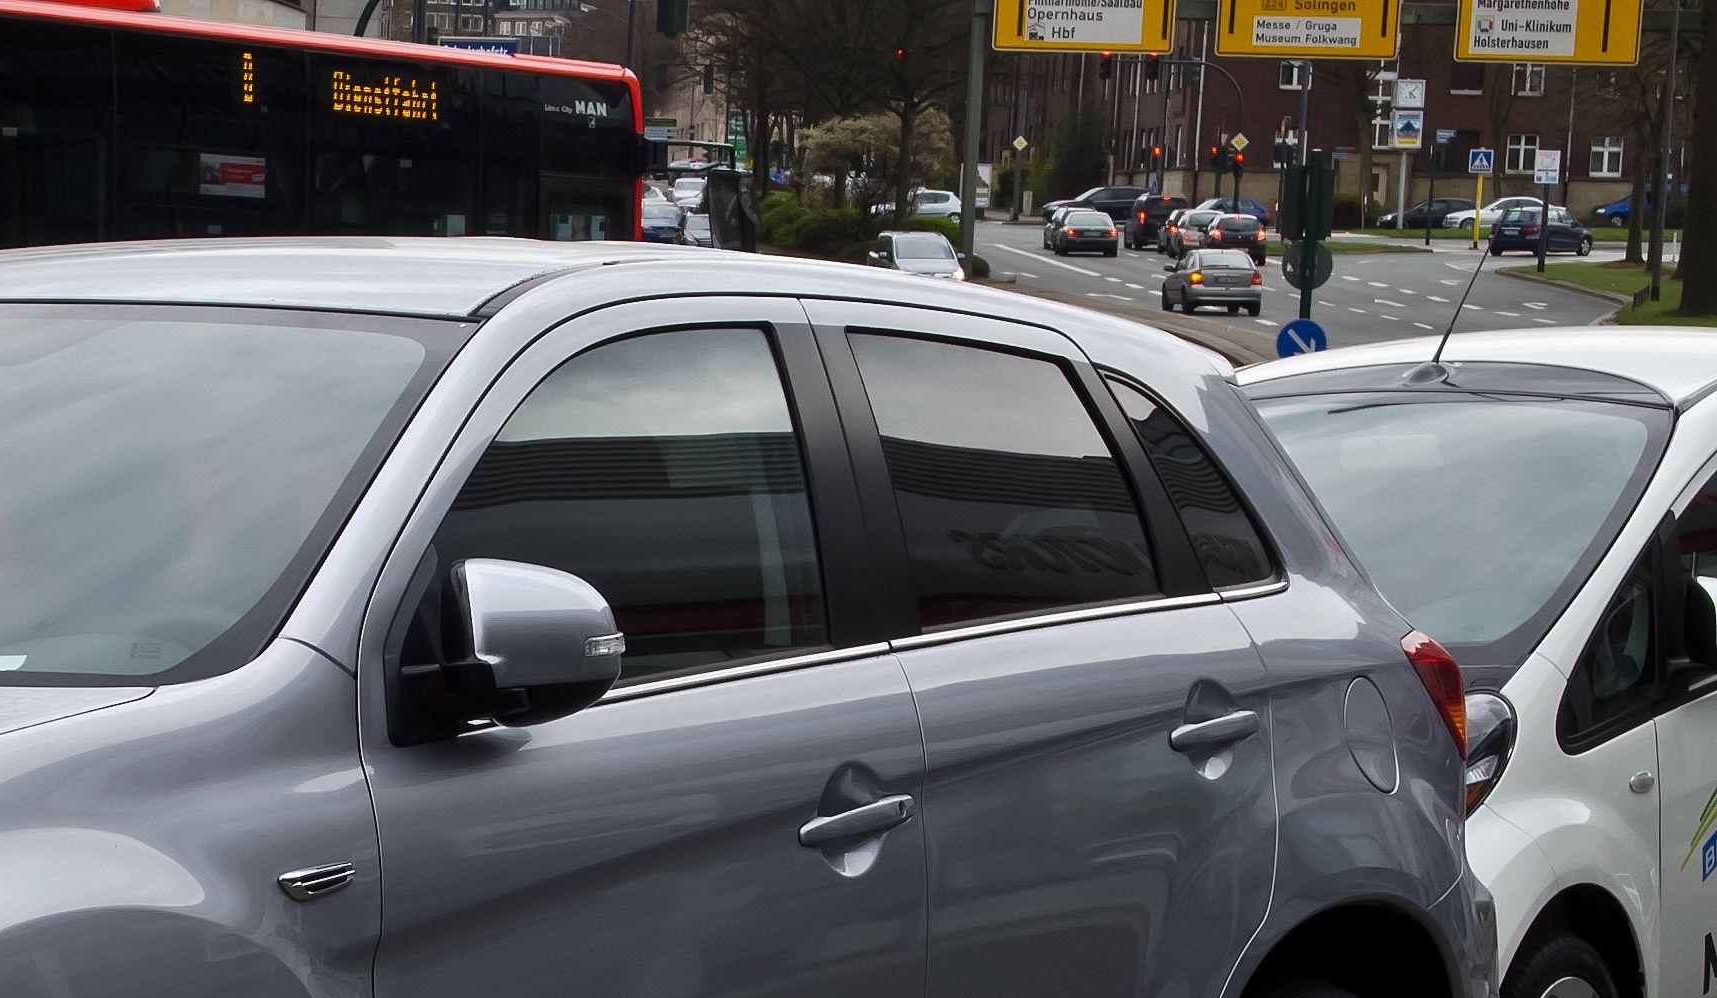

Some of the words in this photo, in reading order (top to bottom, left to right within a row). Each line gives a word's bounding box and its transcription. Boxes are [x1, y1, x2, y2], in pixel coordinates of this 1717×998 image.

[1294, 0, 1356, 13] Solingen
[1027, 8, 1103, 22] Opernhaus
[1051, 26, 1075, 39] Hbf
[1256, 20, 1291, 31] Messe
[1305, 21, 1337, 33] Gruga
[1501, 19, 1572, 34] Uni-Klinikum
[1255, 33, 1301, 44] Museum
[1305, 34, 1357, 47] Folkwang
[1473, 35, 1549, 50] Holsterhausen
[333, 71, 438, 120] Dienstfahrt
[574, 100, 607, 117] MAN
